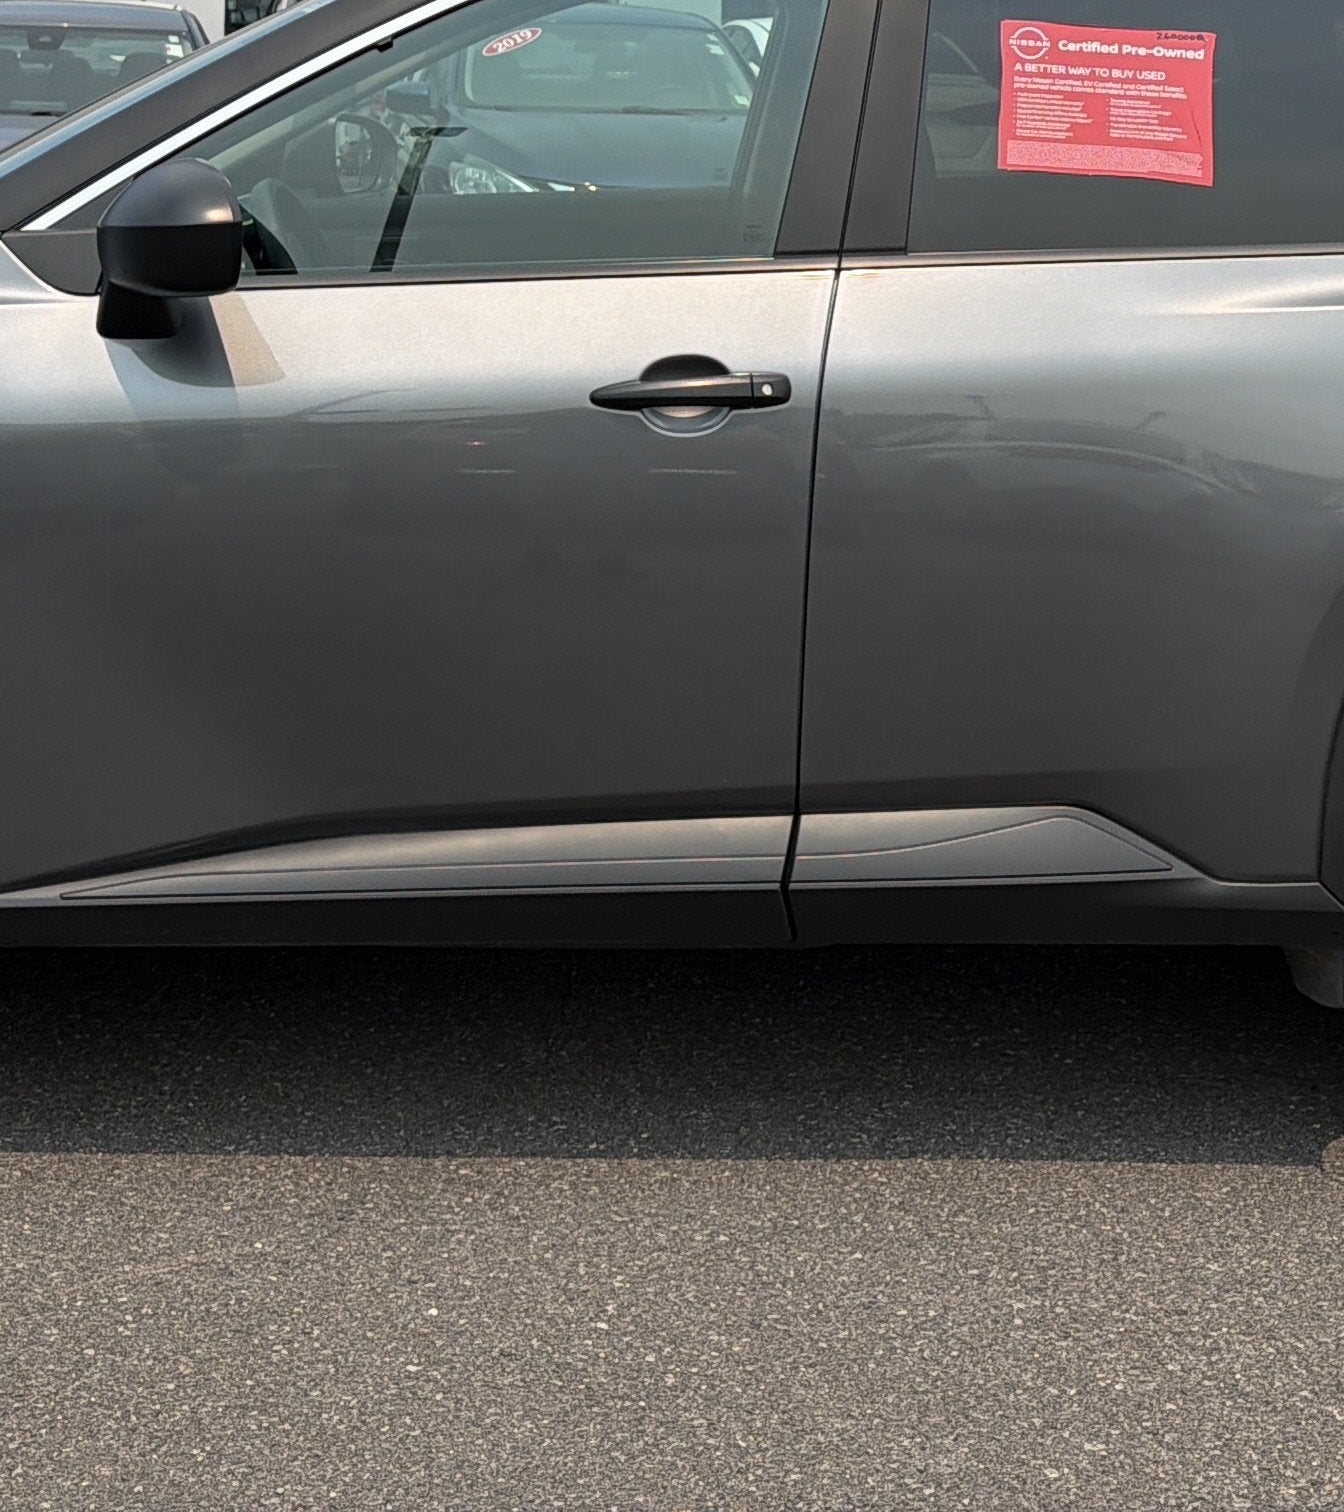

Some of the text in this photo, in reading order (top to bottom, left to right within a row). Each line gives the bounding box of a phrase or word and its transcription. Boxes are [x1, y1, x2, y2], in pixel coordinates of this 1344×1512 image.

[492, 30, 532, 53] 2019
[1009, 38, 1051, 48] NISSAN
[1058, 39, 1205, 60] Certified Pre-Owned
[1013, 62, 1167, 81] A BETTER WAY TO BUY USED
